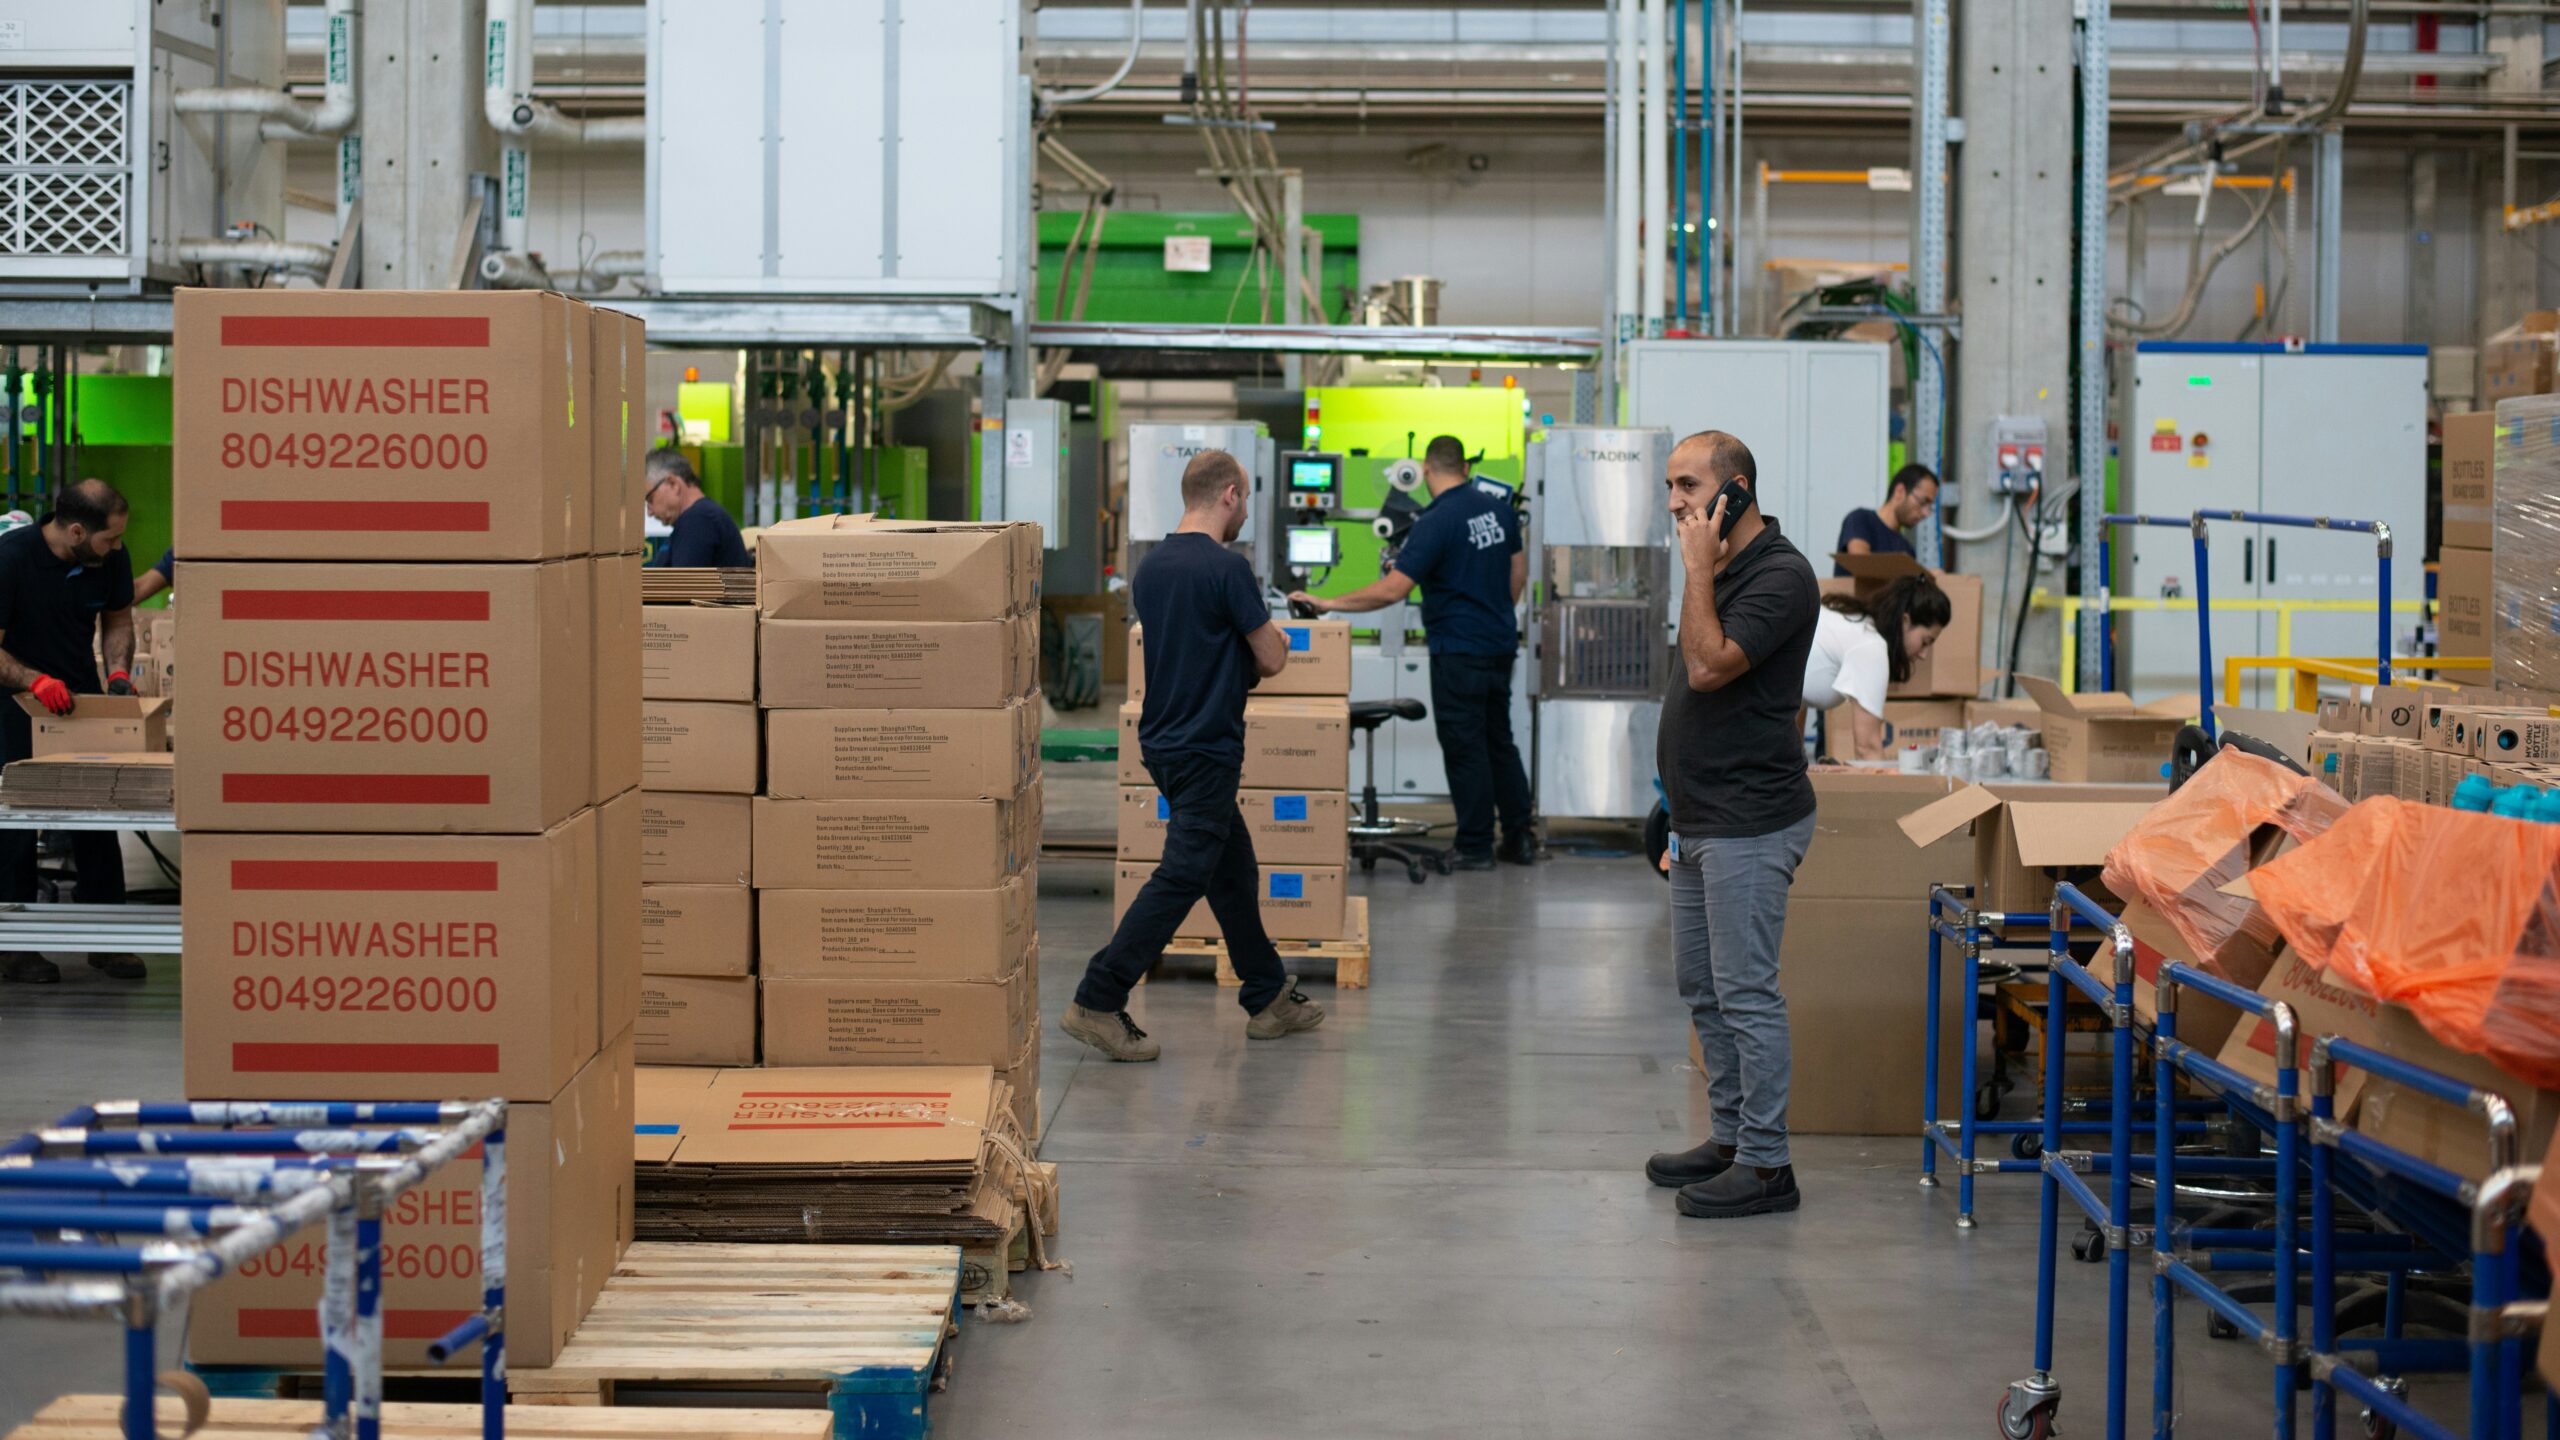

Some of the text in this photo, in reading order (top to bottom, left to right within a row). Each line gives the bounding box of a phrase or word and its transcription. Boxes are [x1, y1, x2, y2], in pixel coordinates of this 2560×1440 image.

[224, 378, 488, 414] DISHWASHER
[222, 432, 488, 469] 8049226000
[1590, 451, 1640, 462] TADBIK
[2453, 461, 2484, 479] BOTTLES
[1467, 511, 1498, 535] צוות
[1468, 526, 1505, 550] טכני
[2448, 595, 2480, 616] BOTTLES
[224, 652, 488, 688] DISHWASHER
[1286, 656, 1320, 664] stream
[224, 707, 488, 743] 8049226000
[1261, 747, 1316, 757] sodastream
[2525, 745, 2532, 758] MY
[2533, 723, 2541, 758] BOTTLE
[1260, 823, 1314, 833] sodastream
[233, 922, 497, 958] DISHWASHER
[233, 976, 496, 1012] 8049226000
